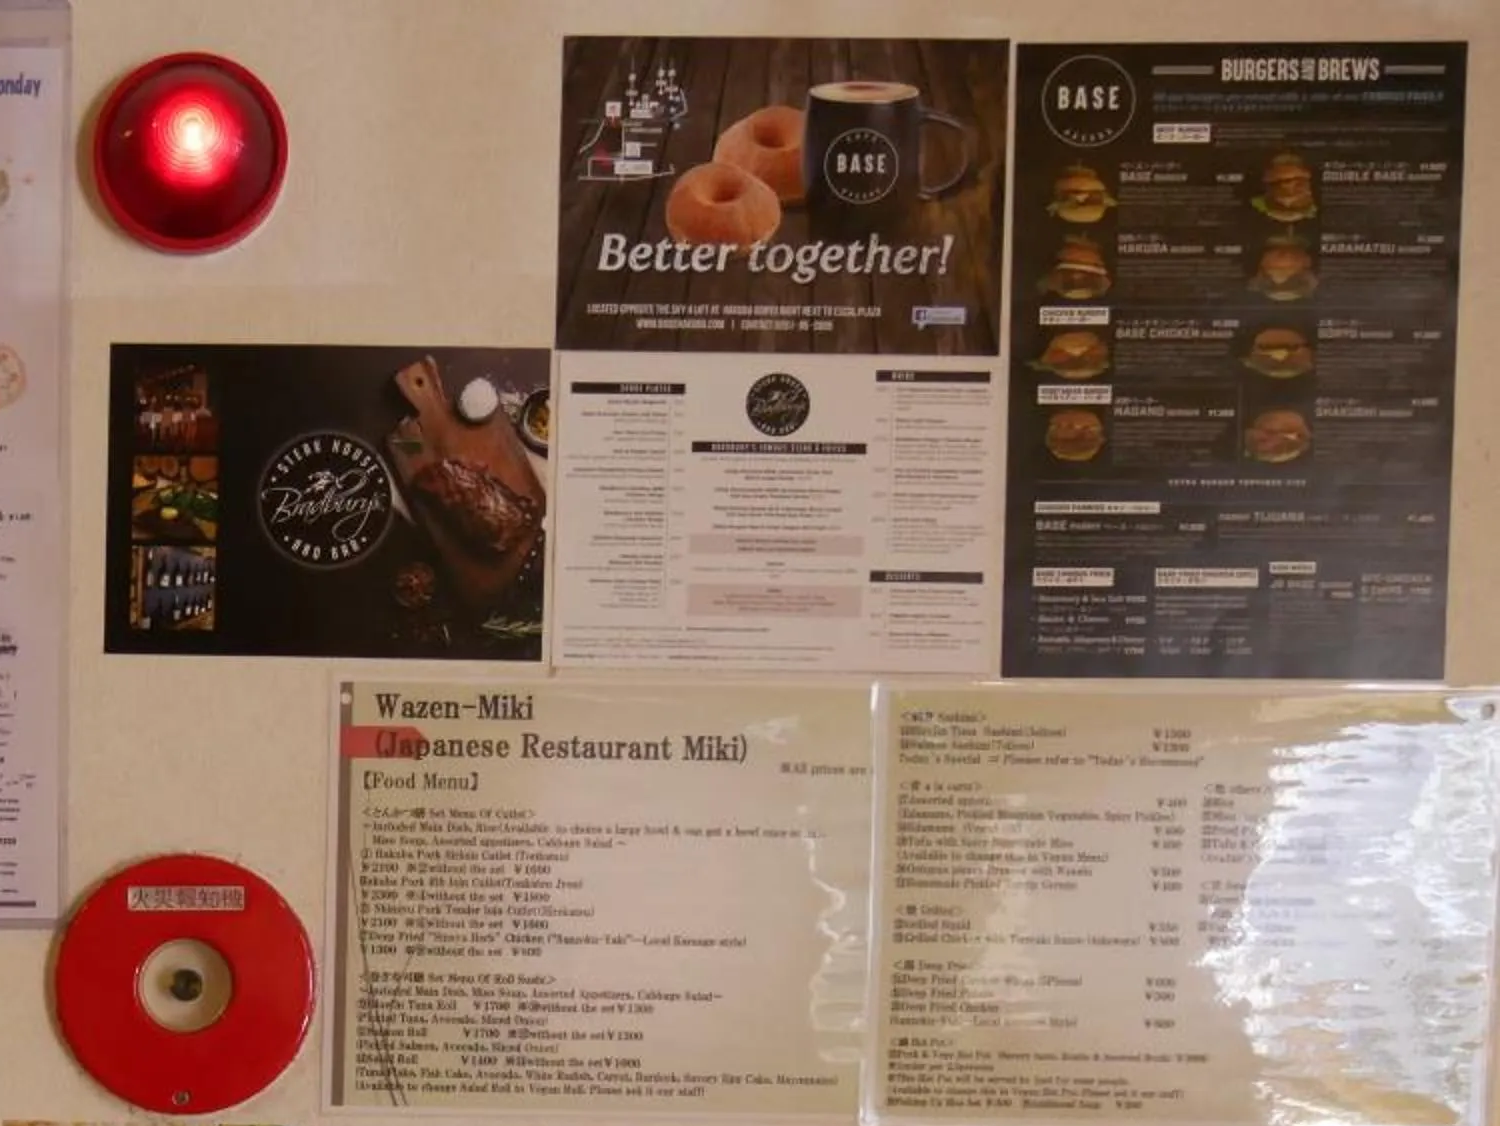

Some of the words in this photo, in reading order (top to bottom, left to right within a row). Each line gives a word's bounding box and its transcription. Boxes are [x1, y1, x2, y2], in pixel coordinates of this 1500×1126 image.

[1221, 58, 1300, 81] BURGERS
[1318, 58, 1380, 81] BREWS
[1057, 86, 1120, 111] BASE
[837, 152, 887, 174] BASE
[598, 232, 738, 272] Better
[748, 233, 955, 283] together!
[376, 694, 534, 720] Wazen-Miki
[375, 731, 509, 761] (Japanese
[521, 735, 672, 761] Restaurant
[682, 735, 748, 763] Miki)
